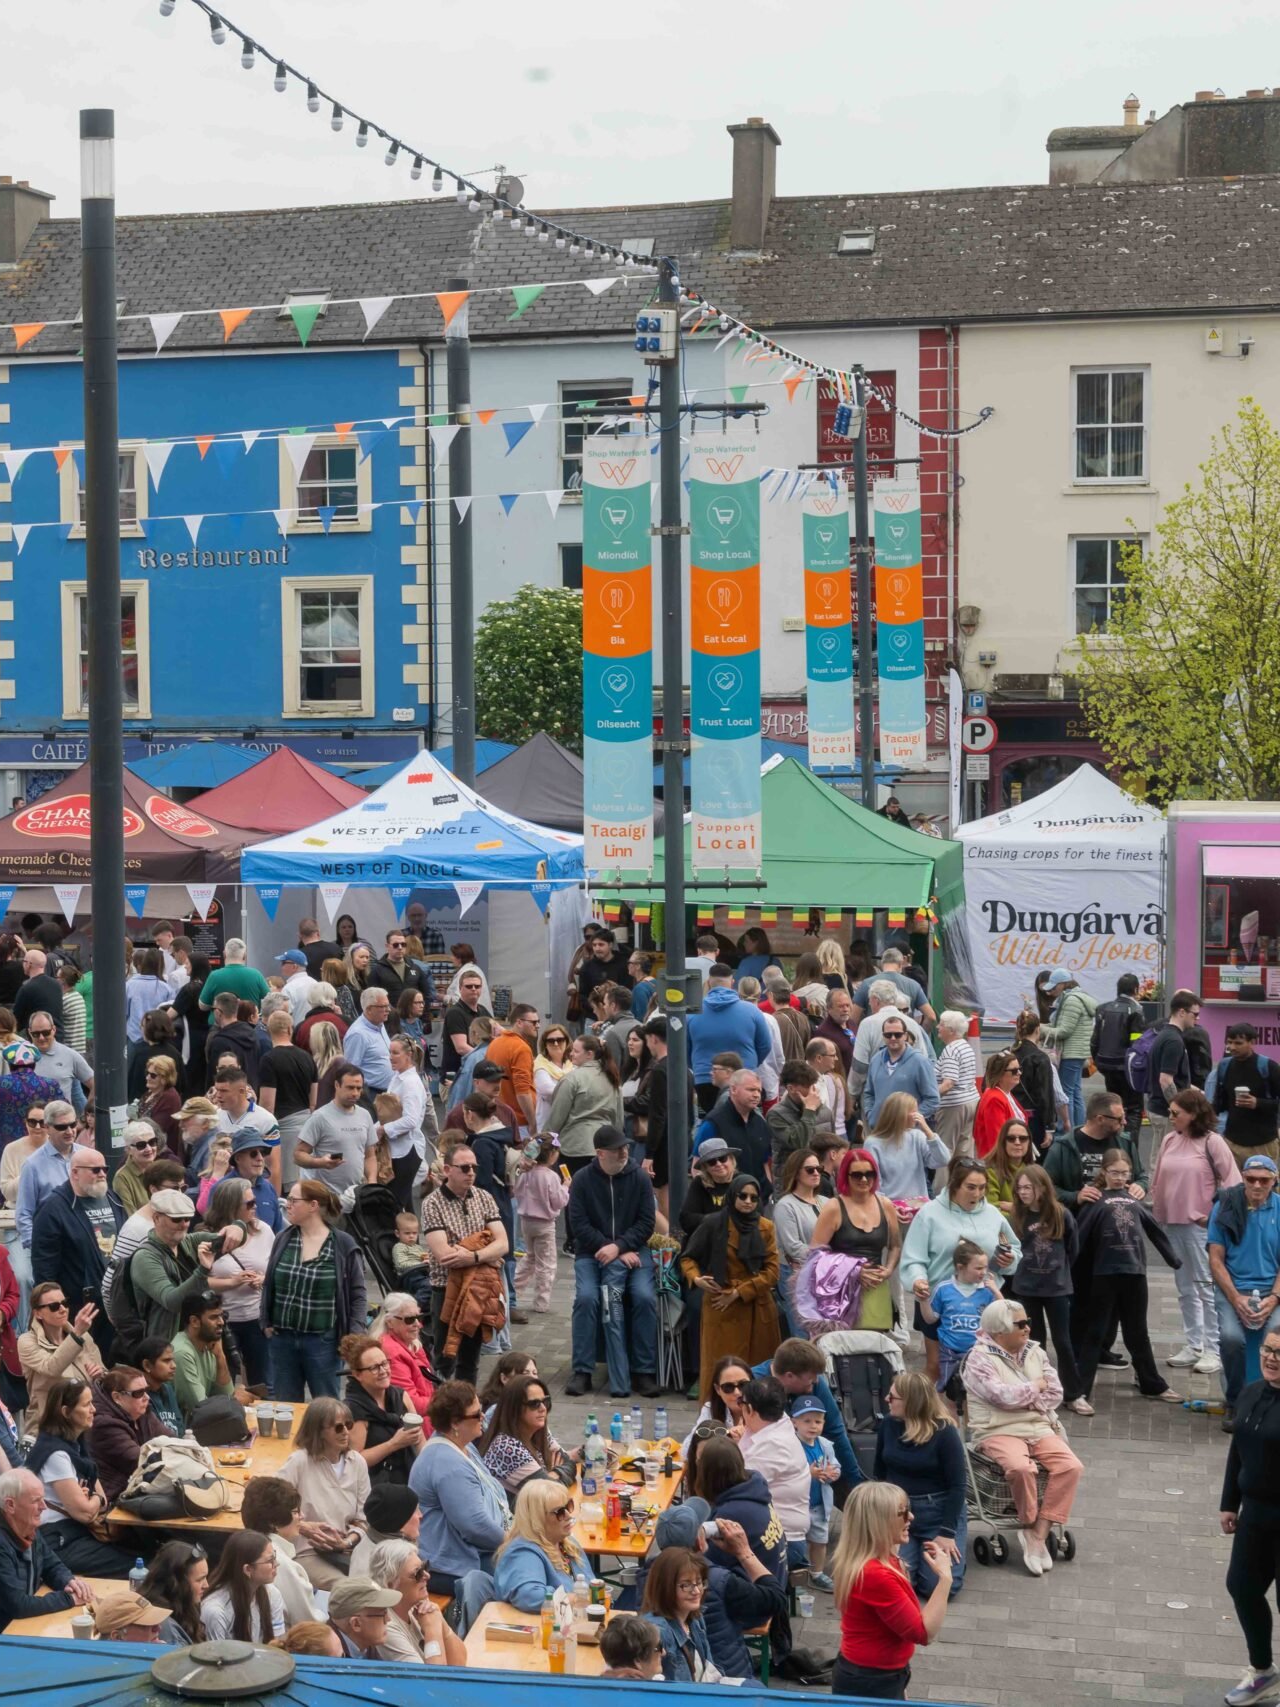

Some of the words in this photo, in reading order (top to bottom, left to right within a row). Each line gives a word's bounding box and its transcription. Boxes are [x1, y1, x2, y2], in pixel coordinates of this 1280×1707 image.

[138, 545, 288, 568] Restaurant
[700, 551, 724, 560] Shop
[726, 550, 751, 559] Local
[610, 636, 625, 645] Bia
[704, 635, 719, 643] Eat
[721, 634, 747, 643] Local
[973, 695, 982, 707] P
[699, 718, 723, 726] Trust
[727, 718, 752, 726] Local
[970, 723, 986, 744] P
[32, 739, 87, 760] CAIFÉ
[812, 744, 851, 754] Local
[893, 748, 913, 756] Linn
[1033, 813, 1144, 829] Dungarvan
[332, 827, 380, 835] WEST
[385, 827, 408, 835] OF
[415, 826, 481, 835] DINGLE
[697, 822, 754, 833] Support
[698, 836, 755, 849] Local
[604, 844, 632, 857] Linn
[968, 847, 1018, 861] Chasing
[1023, 850, 1059, 861] crops
[1064, 848, 1084, 859] for
[1090, 848, 1111, 860] the
[1115, 848, 1153, 861] finest
[320, 863, 364, 876] WEST
[372, 862, 393, 874] OF
[400, 863, 462, 877] DINGLE
[982, 900, 1165, 943] Dungarva
[989, 933, 1064, 965] Wild
[952, 1318, 979, 1330] AIG
